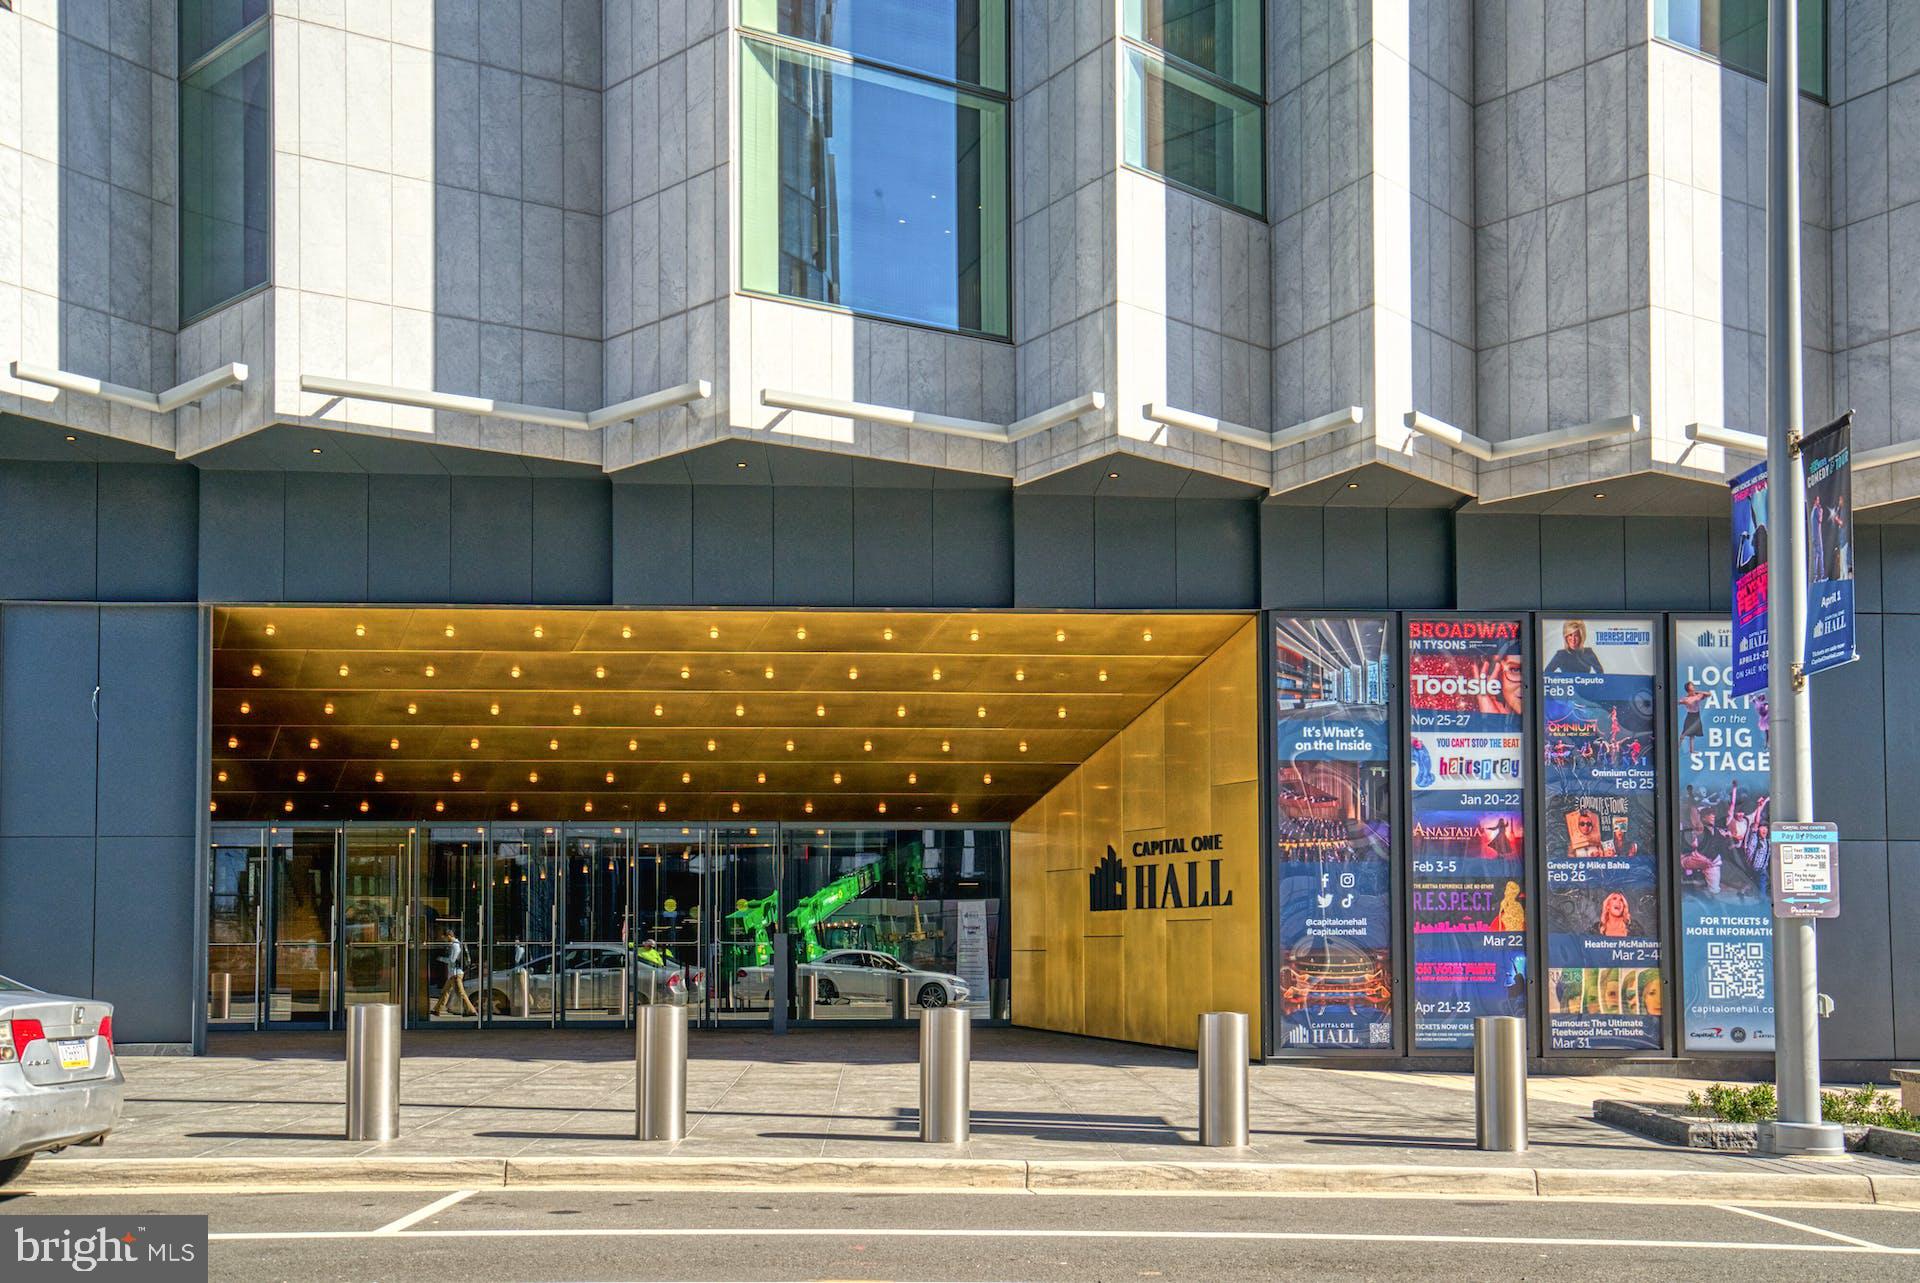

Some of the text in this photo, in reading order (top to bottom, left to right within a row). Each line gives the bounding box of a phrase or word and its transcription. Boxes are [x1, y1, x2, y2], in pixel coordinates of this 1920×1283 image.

[1821, 591, 1837, 608] April
[1409, 621, 1520, 638] BROADWAY
[1824, 615, 1846, 635] HALL
[1409, 640, 1420, 649] IN
[1423, 640, 1466, 650] TYSONS
[1748, 634, 1768, 649] HALL
[1736, 662, 1768, 680] ON SALE NO
[1412, 673, 1501, 695] Tootsie
[1575, 677, 1604, 686] Caputo
[1544, 686, 1575, 696] Feb 8
[1411, 714, 1470, 726] Nov 25-27
[1713, 714, 1746, 723] on the
[1303, 726, 1364, 738] It's What's
[1549, 723, 1596, 732] OMNIUM
[1436, 738, 1520, 748] YOU CAN'T STOP THE BEAT
[1709, 728, 1752, 747] BIG
[1296, 740, 1372, 750] on the Inside
[1690, 752, 1770, 771] STAGE
[1440, 757, 1520, 780] hairspray
[1616, 778, 1654, 789] Feb 25
[1460, 794, 1520, 804] Jan 20-22
[1412, 822, 1482, 837] ANASTASIA
[1132, 834, 1223, 857] CAPITAL ONE
[1412, 861, 1456, 872] Feb 3-5
[1548, 871, 1586, 882] Feb 26
[1134, 859, 1232, 909] HALL
[1413, 892, 1495, 911] R.E.S.P.E.C.T.
[1306, 918, 1367, 928] @capitalonehall
[1700, 917, 1769, 925] FOR TICKETS &
[1307, 928, 1367, 936] #capitalonehall
[1484, 936, 1523, 946] Mar 22
[1612, 950, 1659, 960] Mar 2-4
[1415, 1001, 1470, 1014] Apr 21-23
[1692, 1005, 1774, 1014] capitalonehall.co
[1312, 1030, 1358, 1043] HALL
[1552, 1028, 1644, 1036] Fleetwood Mac Tribute
[1552, 1038, 1591, 1048] Mar 31
